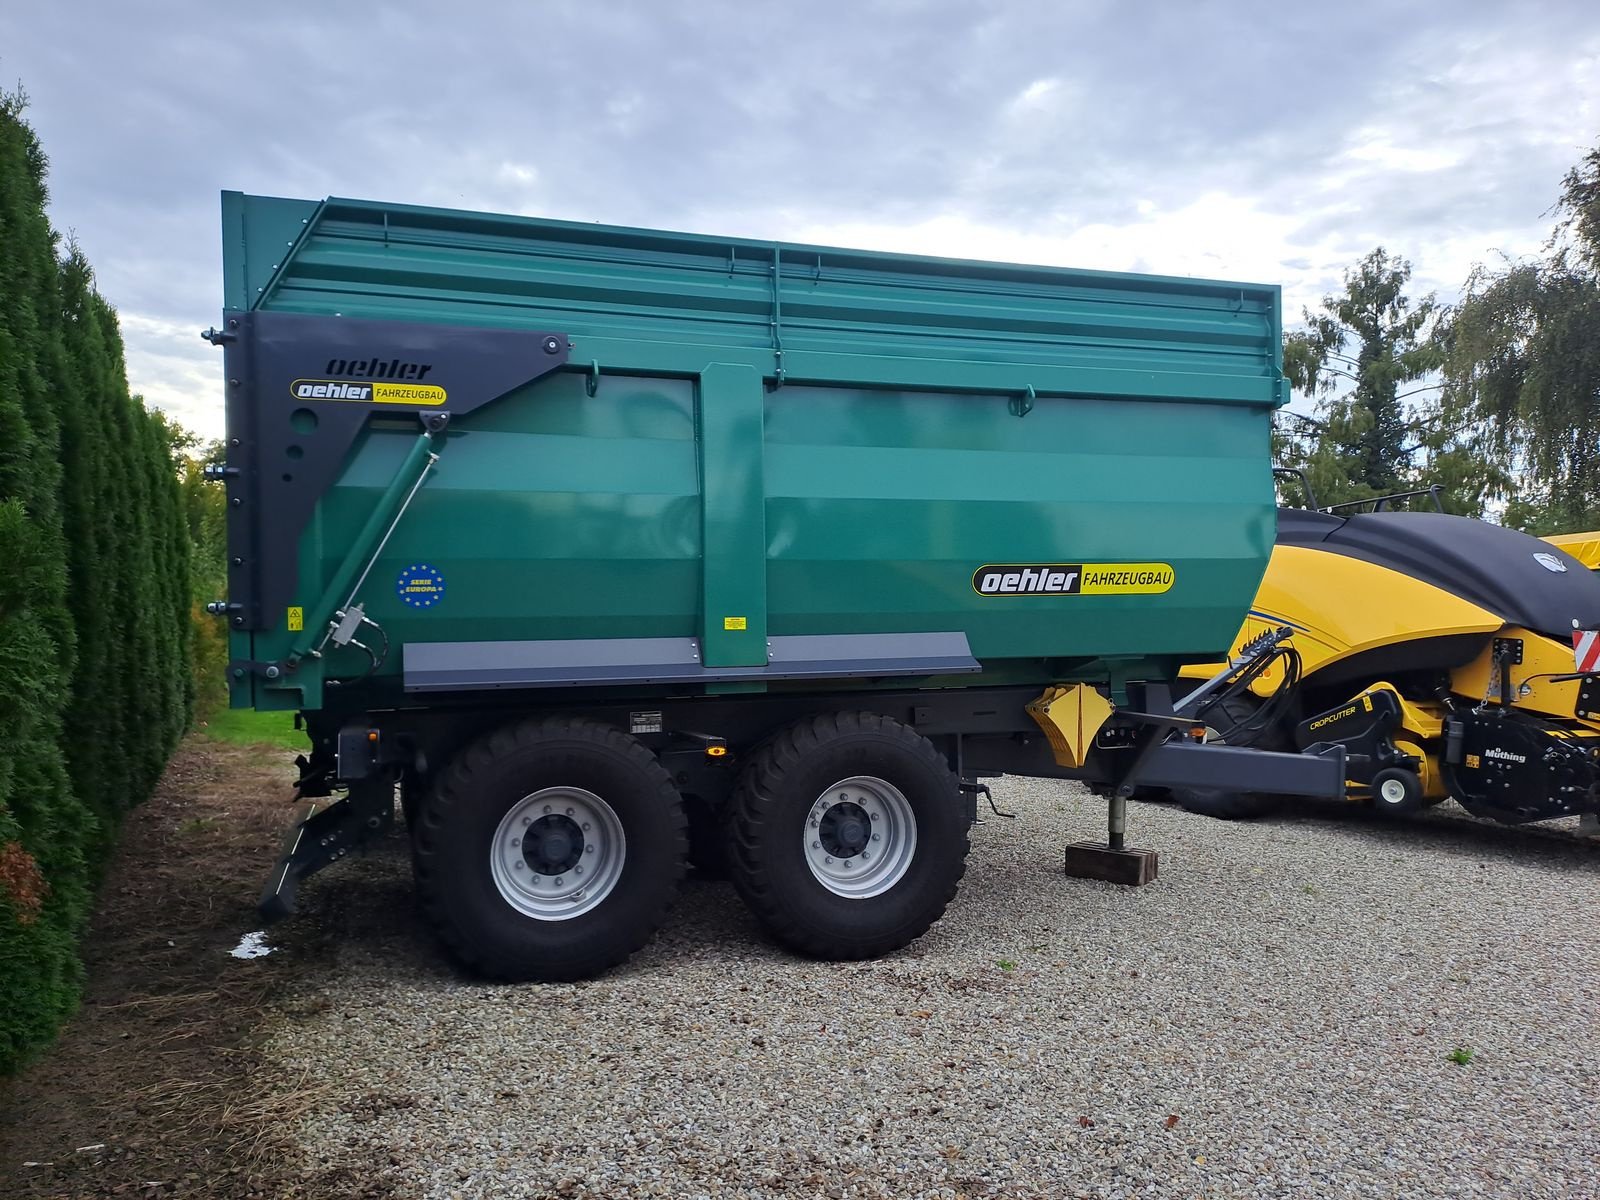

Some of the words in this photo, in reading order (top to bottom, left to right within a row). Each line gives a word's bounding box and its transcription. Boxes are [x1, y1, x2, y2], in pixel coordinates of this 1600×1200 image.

[325, 358, 432, 380] oehler
[297, 383, 371, 400] oehler
[376, 388, 444, 400] FAHRZEUGBAU
[980, 568, 1079, 592] oehler
[1083, 571, 1172, 586] FAHRZEUGBAU
[1310, 706, 1356, 730] CROPCUTTER
